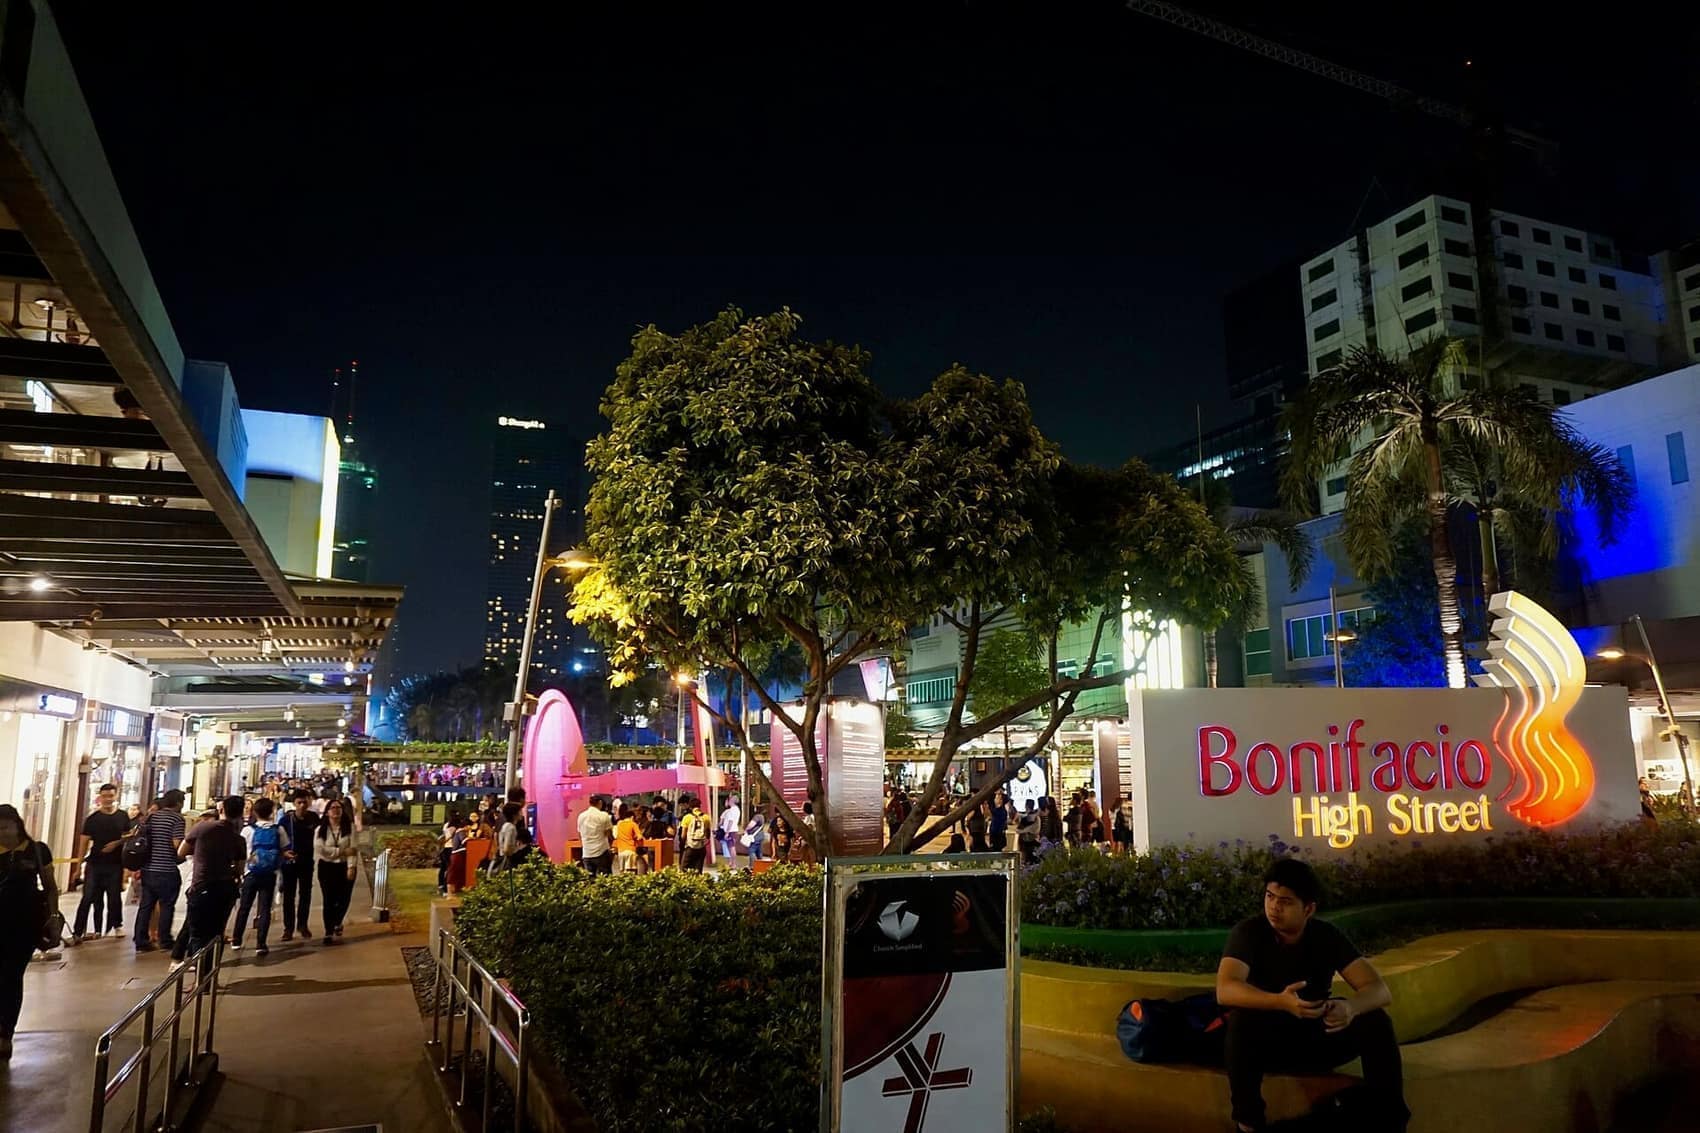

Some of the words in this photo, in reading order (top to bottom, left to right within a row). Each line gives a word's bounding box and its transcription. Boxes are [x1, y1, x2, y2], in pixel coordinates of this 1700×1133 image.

[1198, 719, 1492, 797] Bonifacio
[1293, 792, 1372, 848] High
[1387, 794, 1493, 834] Street
